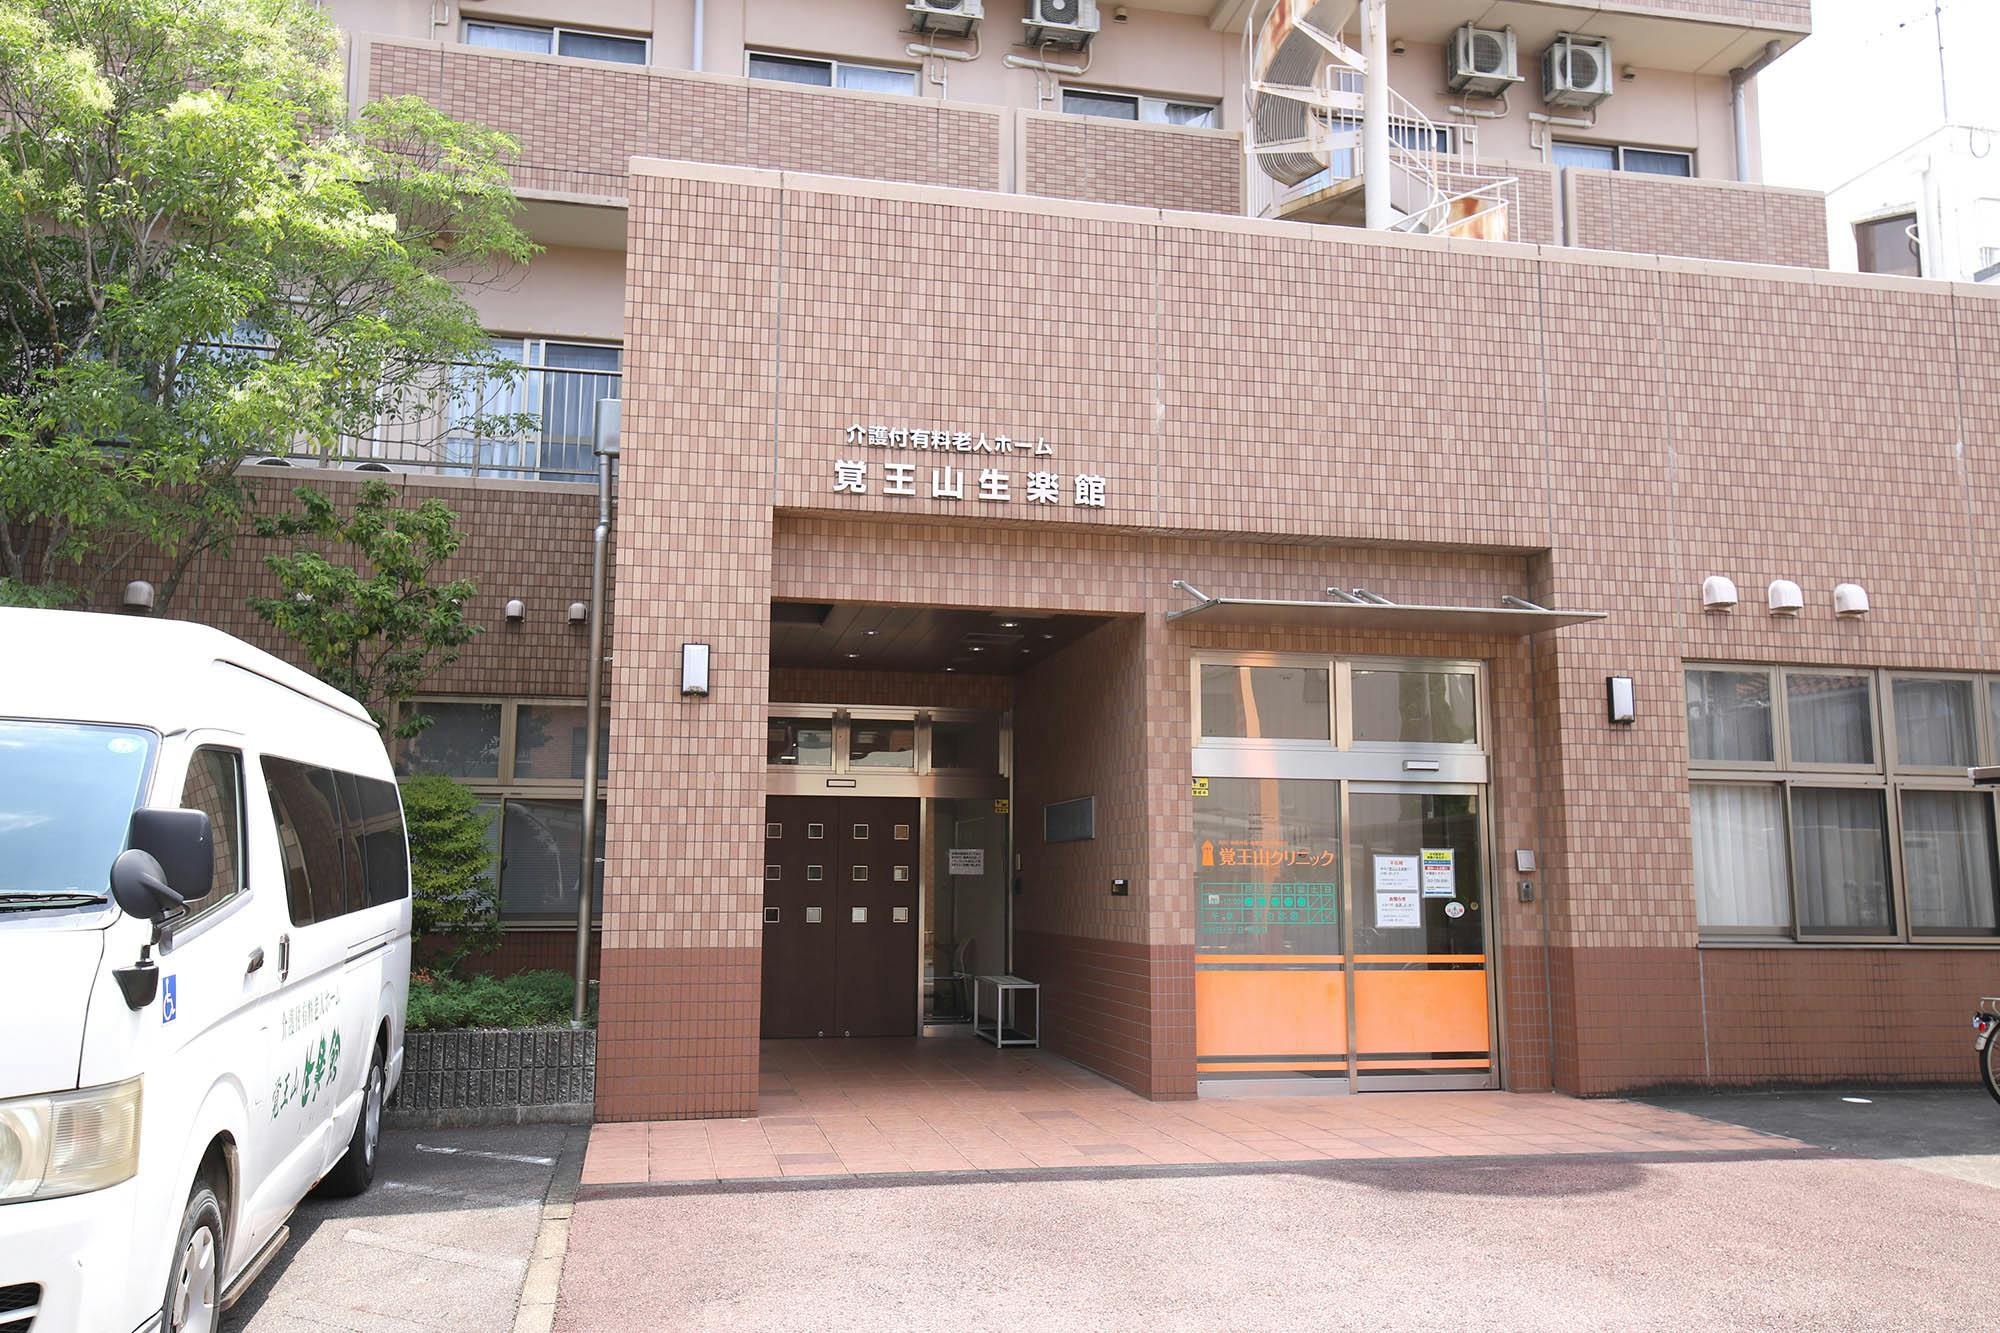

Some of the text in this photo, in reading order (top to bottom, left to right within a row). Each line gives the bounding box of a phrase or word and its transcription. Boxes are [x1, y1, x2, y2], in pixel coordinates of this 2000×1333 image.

[846, 424, 1054, 456] 介護付有料老人ホーム
[832, 459, 1107, 507] 覚王山生楽館
[1219, 847, 1335, 867] 覚王山クリニック
